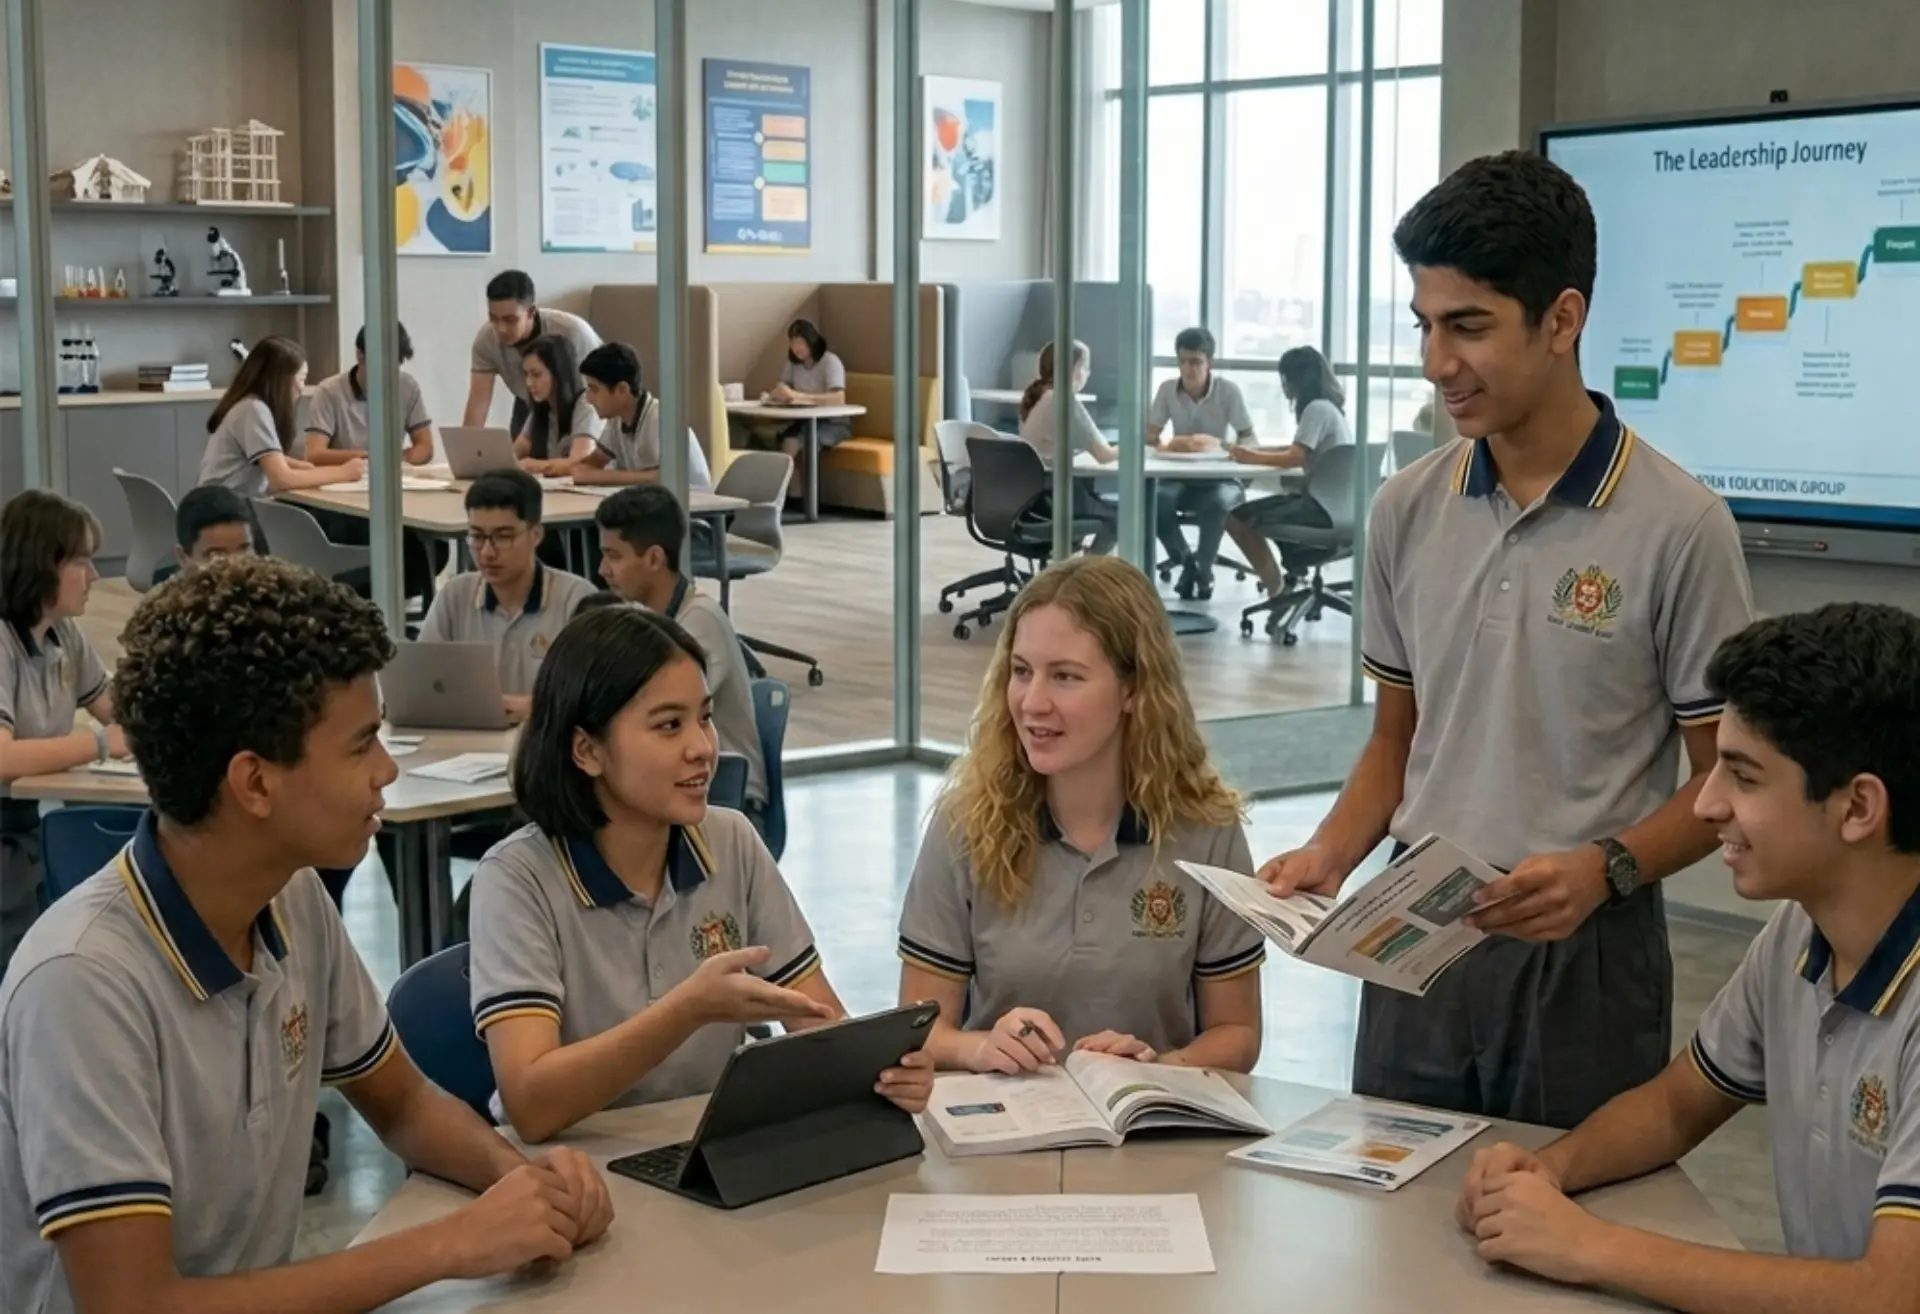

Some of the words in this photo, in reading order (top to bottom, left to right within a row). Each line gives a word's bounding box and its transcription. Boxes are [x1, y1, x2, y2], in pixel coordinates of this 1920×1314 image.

[1653, 150, 1685, 172] The
[1689, 141, 1788, 170] Leadership
[1791, 140, 1868, 165] Journey
